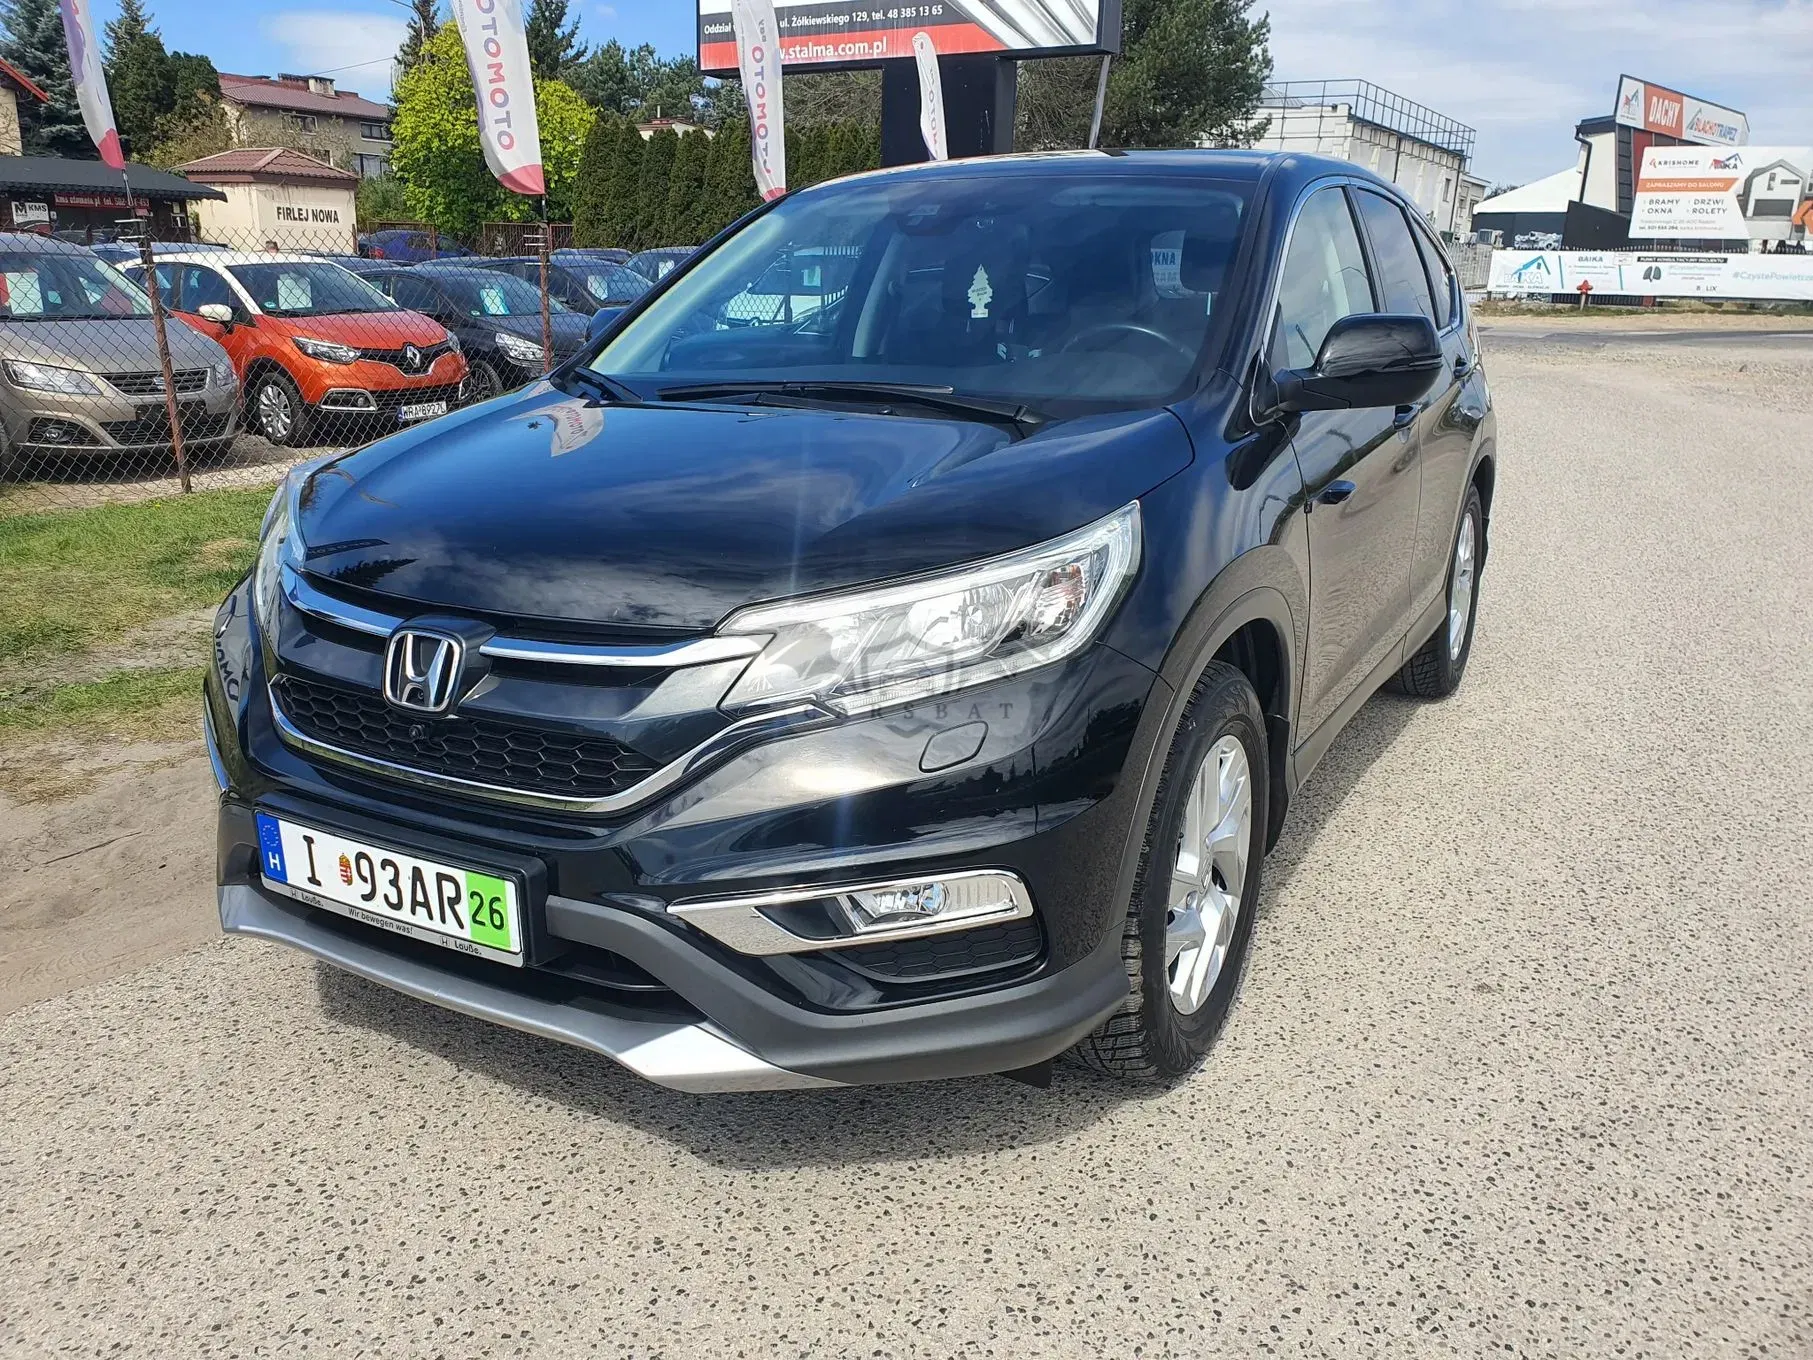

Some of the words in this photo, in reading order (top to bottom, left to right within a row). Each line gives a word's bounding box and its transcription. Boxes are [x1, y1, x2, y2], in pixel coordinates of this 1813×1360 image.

[704, 25, 731, 35] Oddział
[780, 18, 790, 28] ul.
[791, 13, 850, 27] Żółkiewskiego
[852, 11, 869, 22] 129,
[872, 9, 886, 20] tel.
[887, 8, 898, 18] 48
[900, 7, 916, 18] 385
[919, 5, 930, 16] 13
[931, 4, 943, 15] 65
[1648, 96, 1681, 128] DACHY
[28, 204, 47, 212] KMS
[276, 206, 309, 222] FIRLEJ
[311, 208, 340, 224] NOWA
[1647, 207, 1673, 215] OKNA
[1691, 207, 1728, 215] ROLETY
[1151, 251, 1176, 266] KNA
[268, 851, 281, 871] H
[302, 834, 322, 887] I
[354, 851, 465, 930] 93AR
[469, 890, 505, 930] 26
[348, 907, 360, 919] Wir
[361, 910, 395, 931] bewegen
[395, 923, 414, 935] was!
